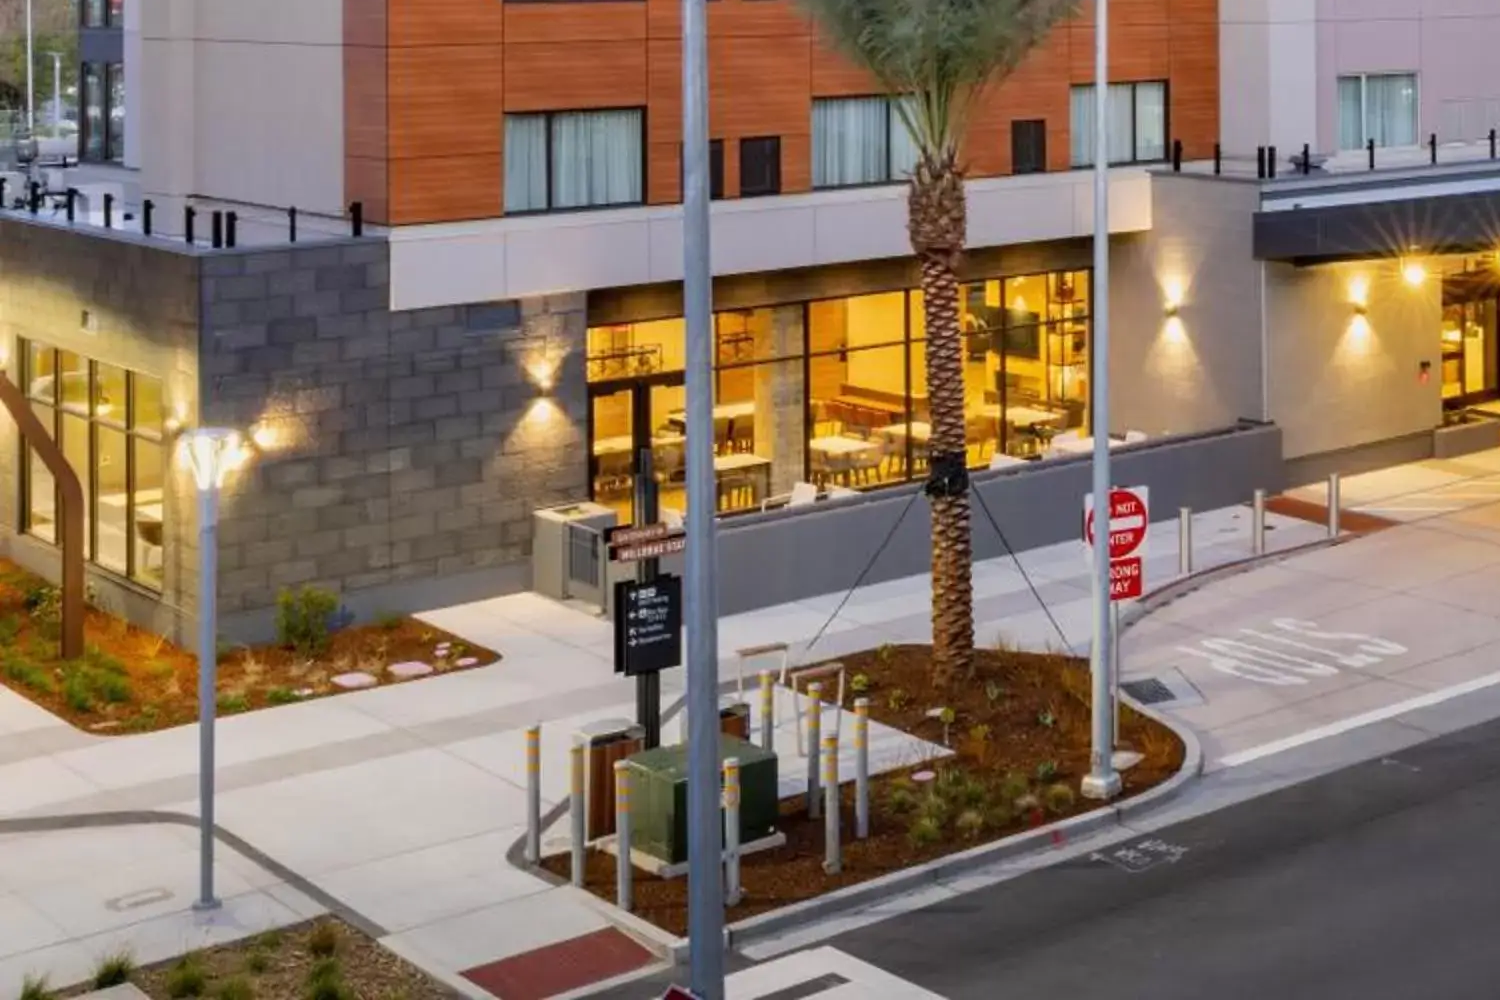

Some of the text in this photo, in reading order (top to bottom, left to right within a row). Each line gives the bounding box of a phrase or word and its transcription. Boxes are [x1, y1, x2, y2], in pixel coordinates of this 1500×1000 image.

[1115, 501, 1138, 515] NOT
[1110, 532, 1135, 547] NTER
[1110, 563, 1139, 579] ONG
